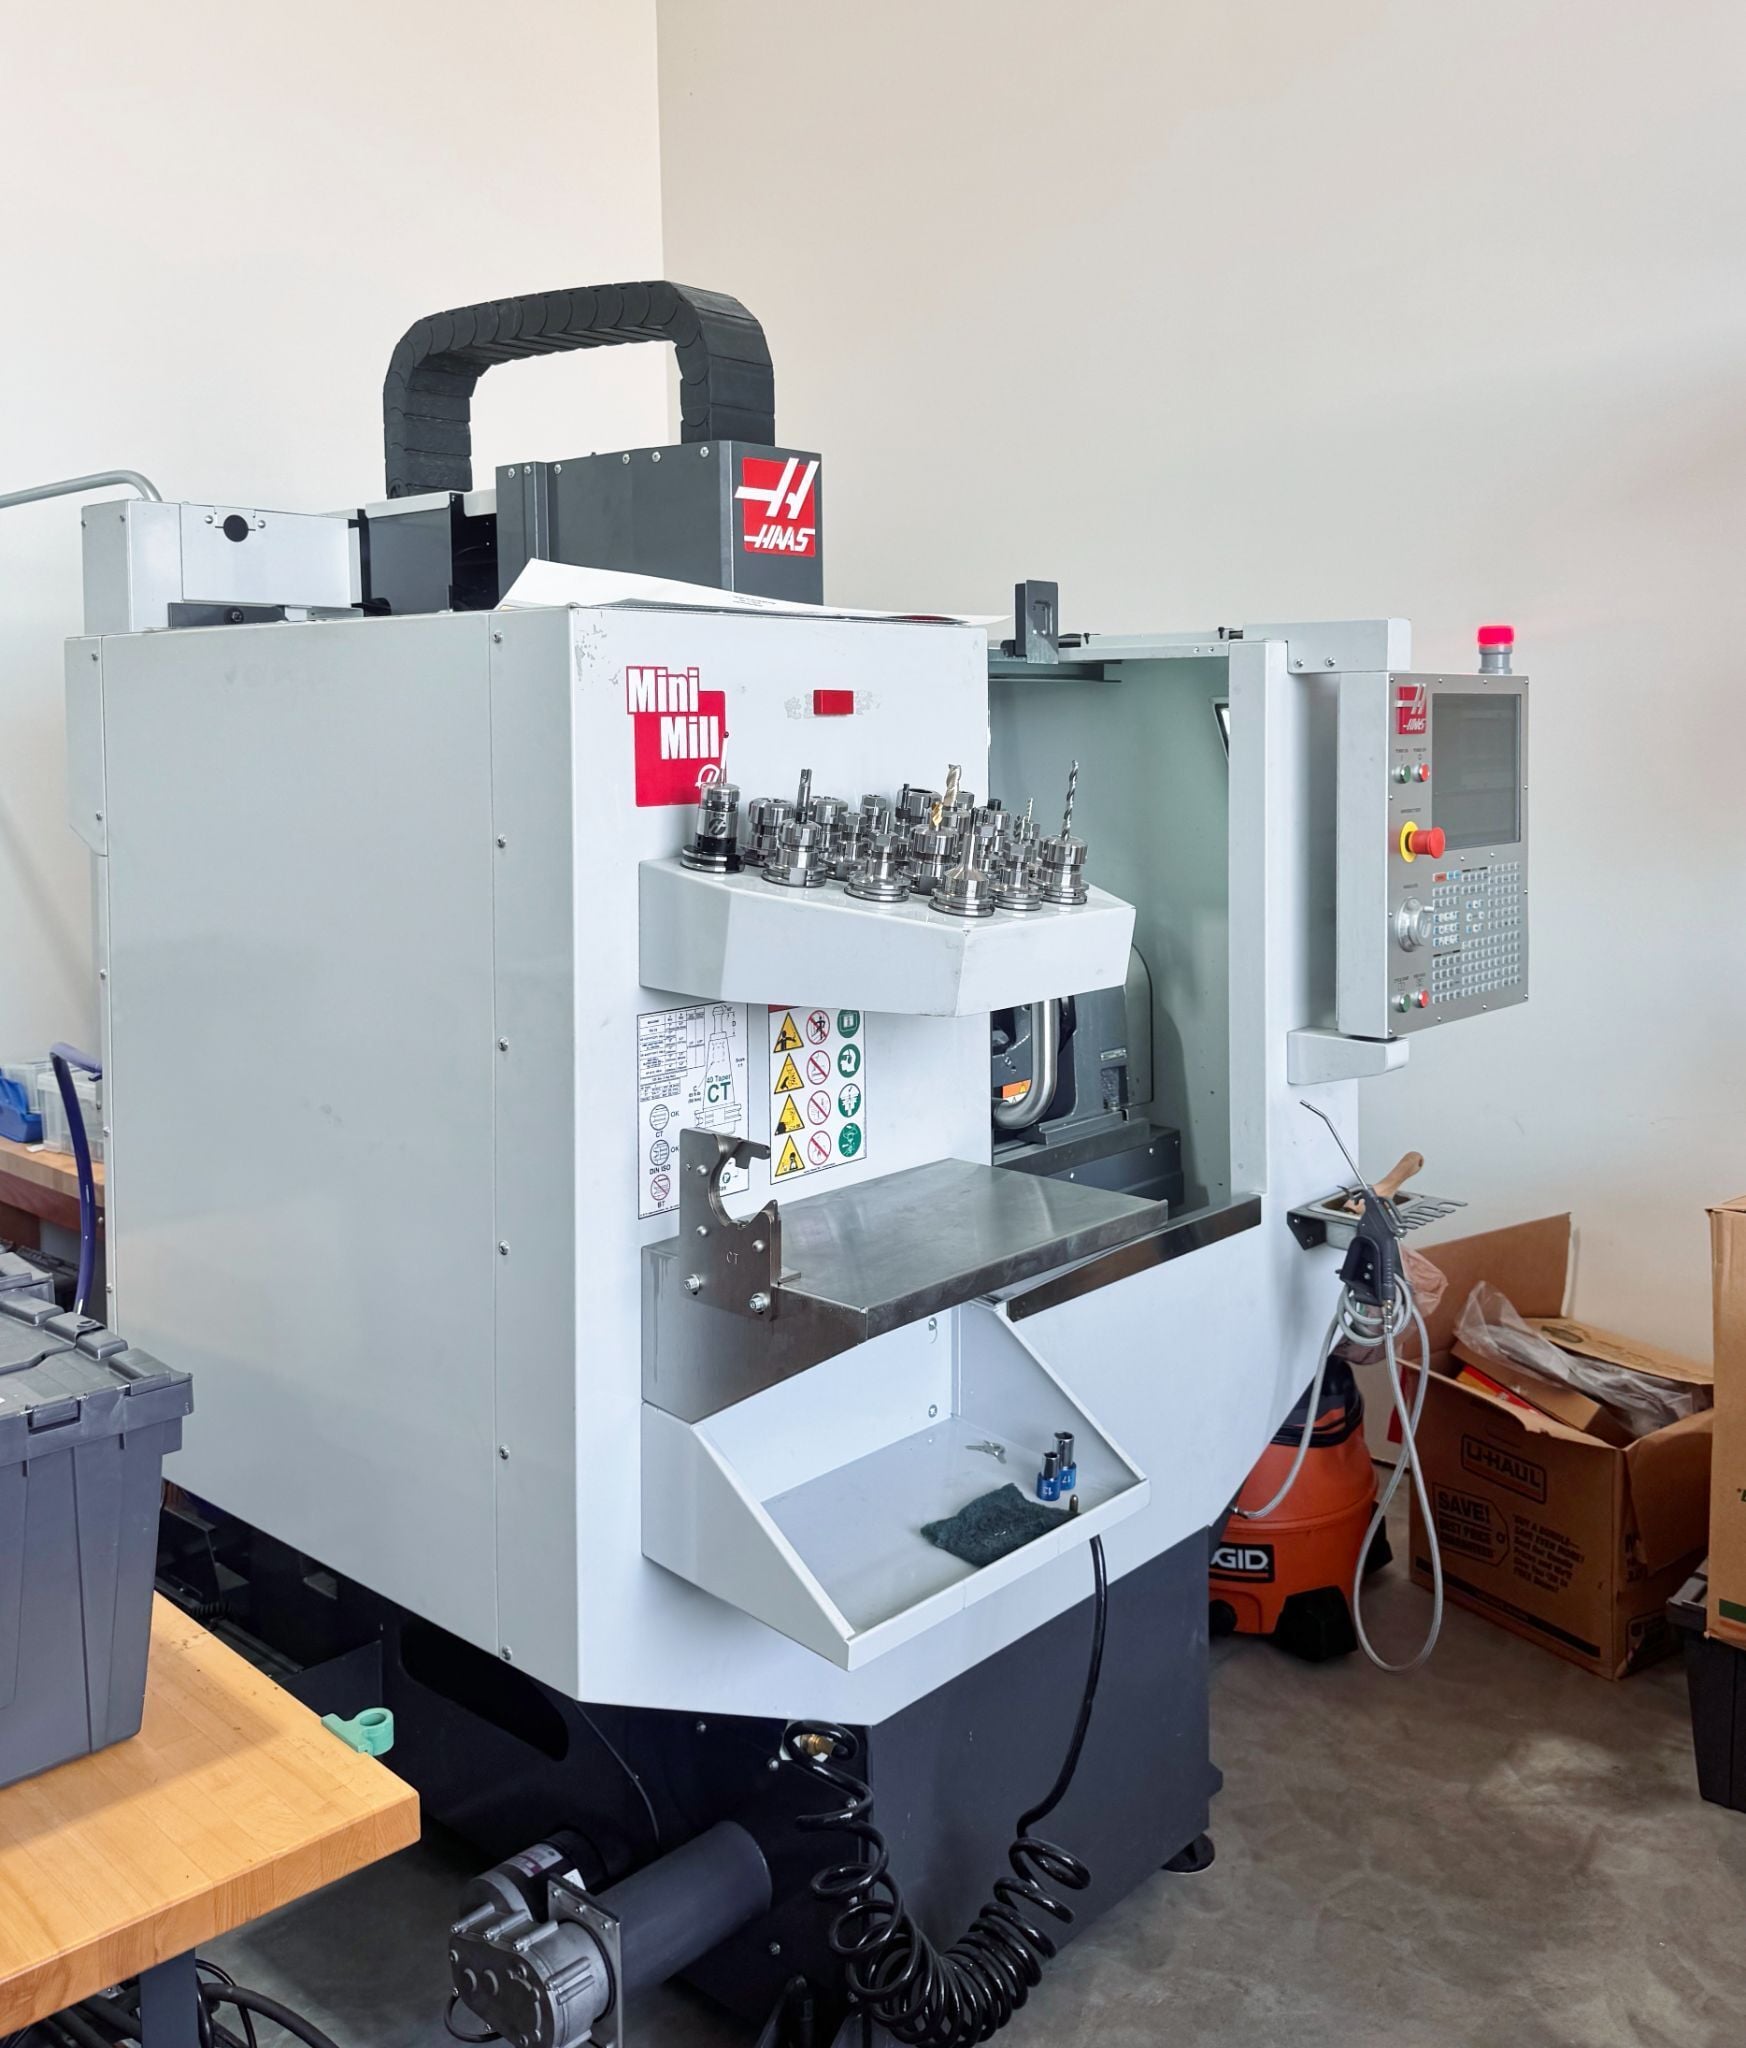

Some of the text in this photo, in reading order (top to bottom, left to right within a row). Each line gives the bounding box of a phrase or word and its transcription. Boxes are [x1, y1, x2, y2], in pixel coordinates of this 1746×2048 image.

[744, 524, 816, 552] HAAS
[626, 667, 699, 713] Mini
[660, 715, 720, 760] Mill
[707, 1081, 731, 1103] CT
[655, 1130, 664, 1138] CT
[726, 1250, 740, 1265] CT
[1466, 1441, 1541, 1488] U-HAUL
[1438, 1491, 1490, 1523] SAVE!
[1210, 1547, 1268, 1570] GID
